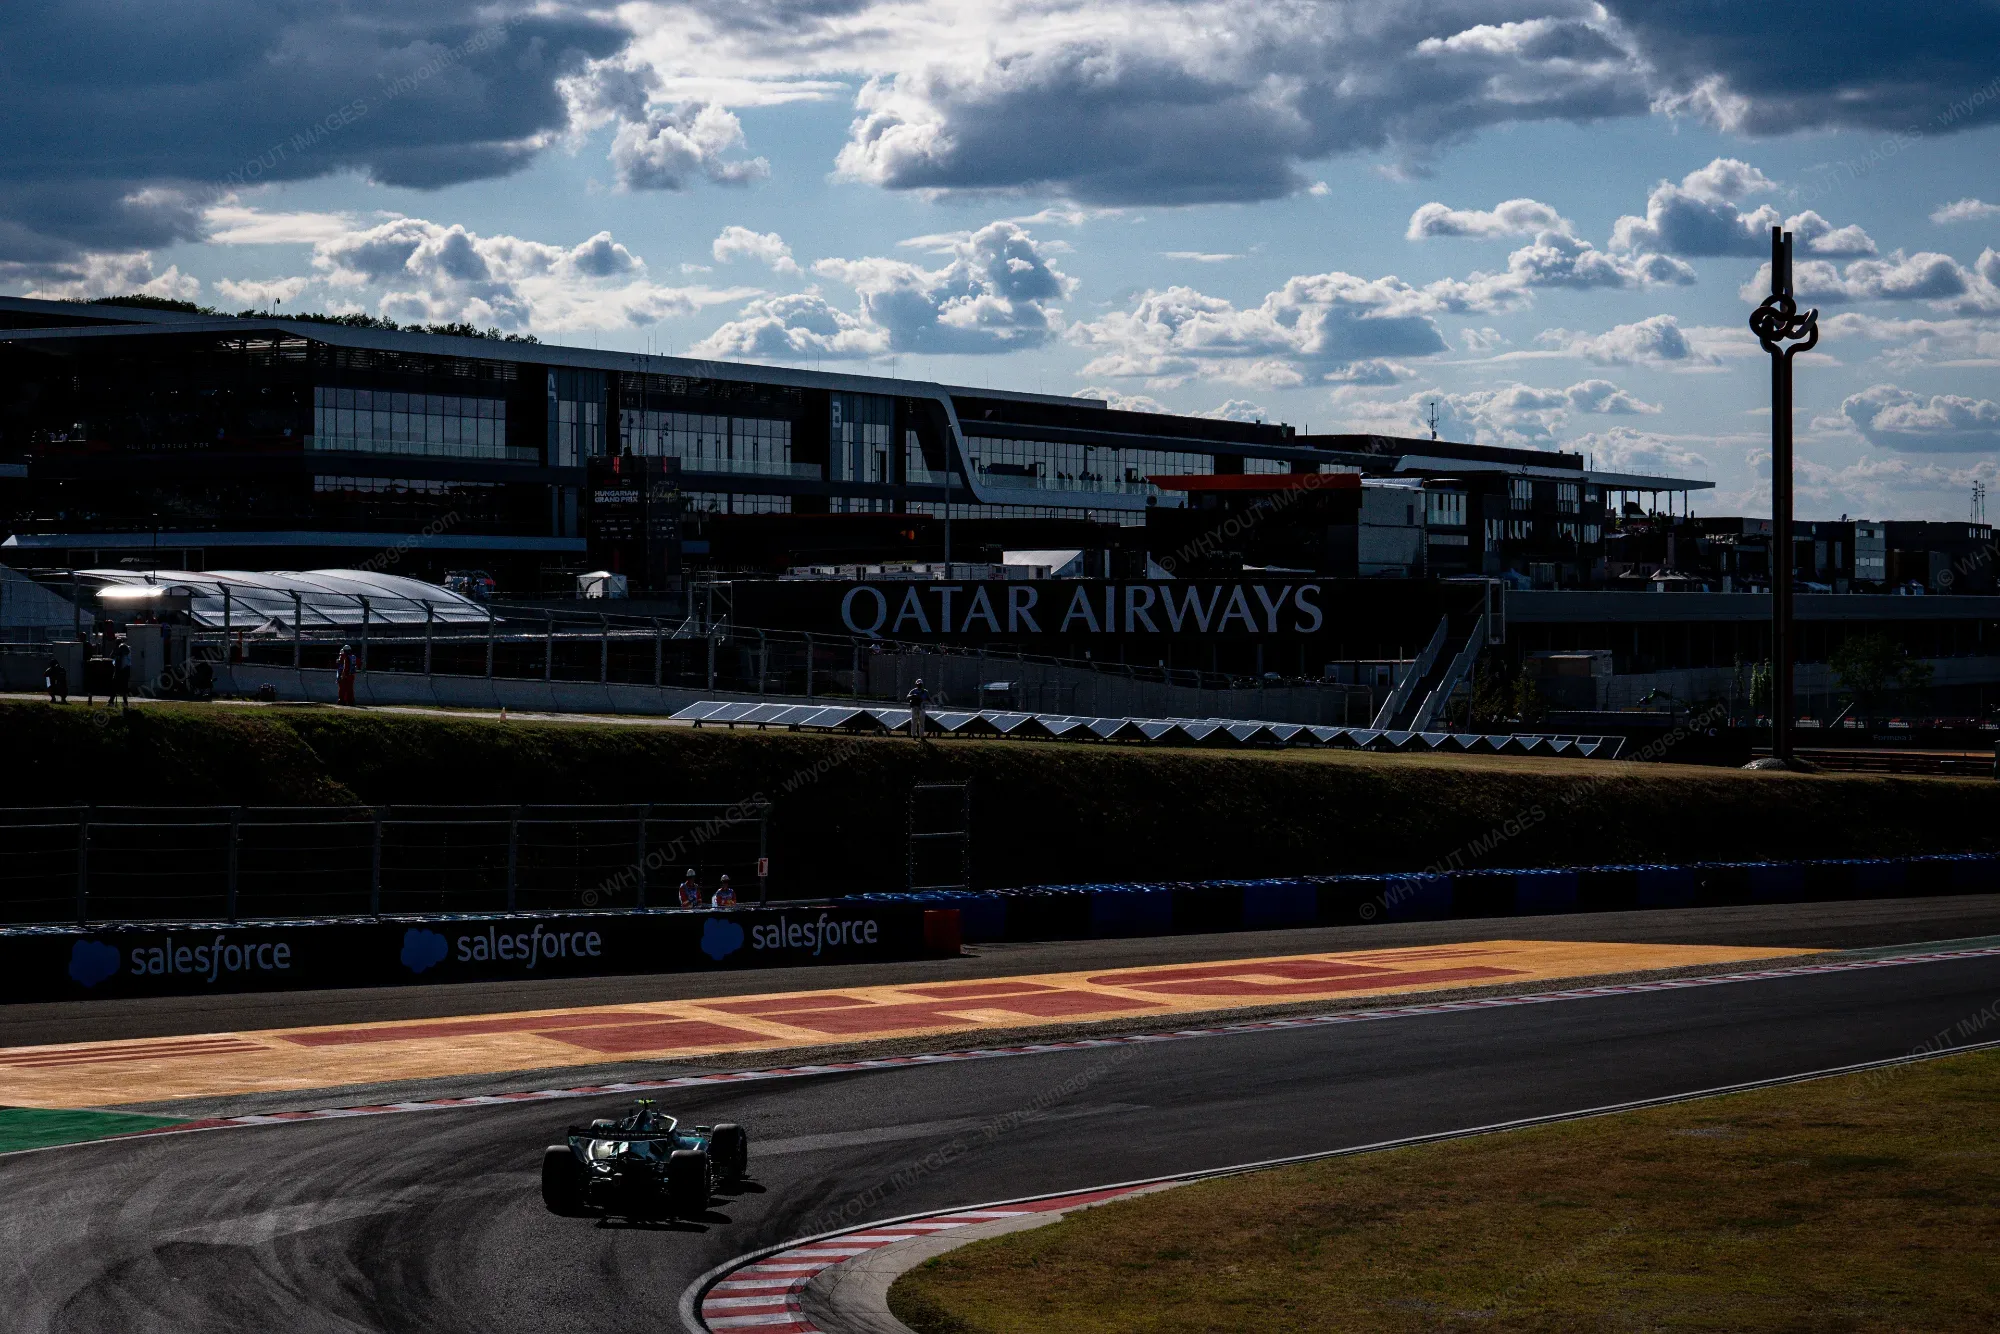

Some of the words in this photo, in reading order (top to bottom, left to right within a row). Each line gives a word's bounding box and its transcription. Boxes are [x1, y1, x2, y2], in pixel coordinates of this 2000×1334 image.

[841, 585, 1042, 638] QATAR
[1060, 585, 1323, 633] AIRWAYS
[457, 924, 602, 967] salesforce
[752, 913, 878, 953] salesforce
[131, 935, 291, 978] salesforce
